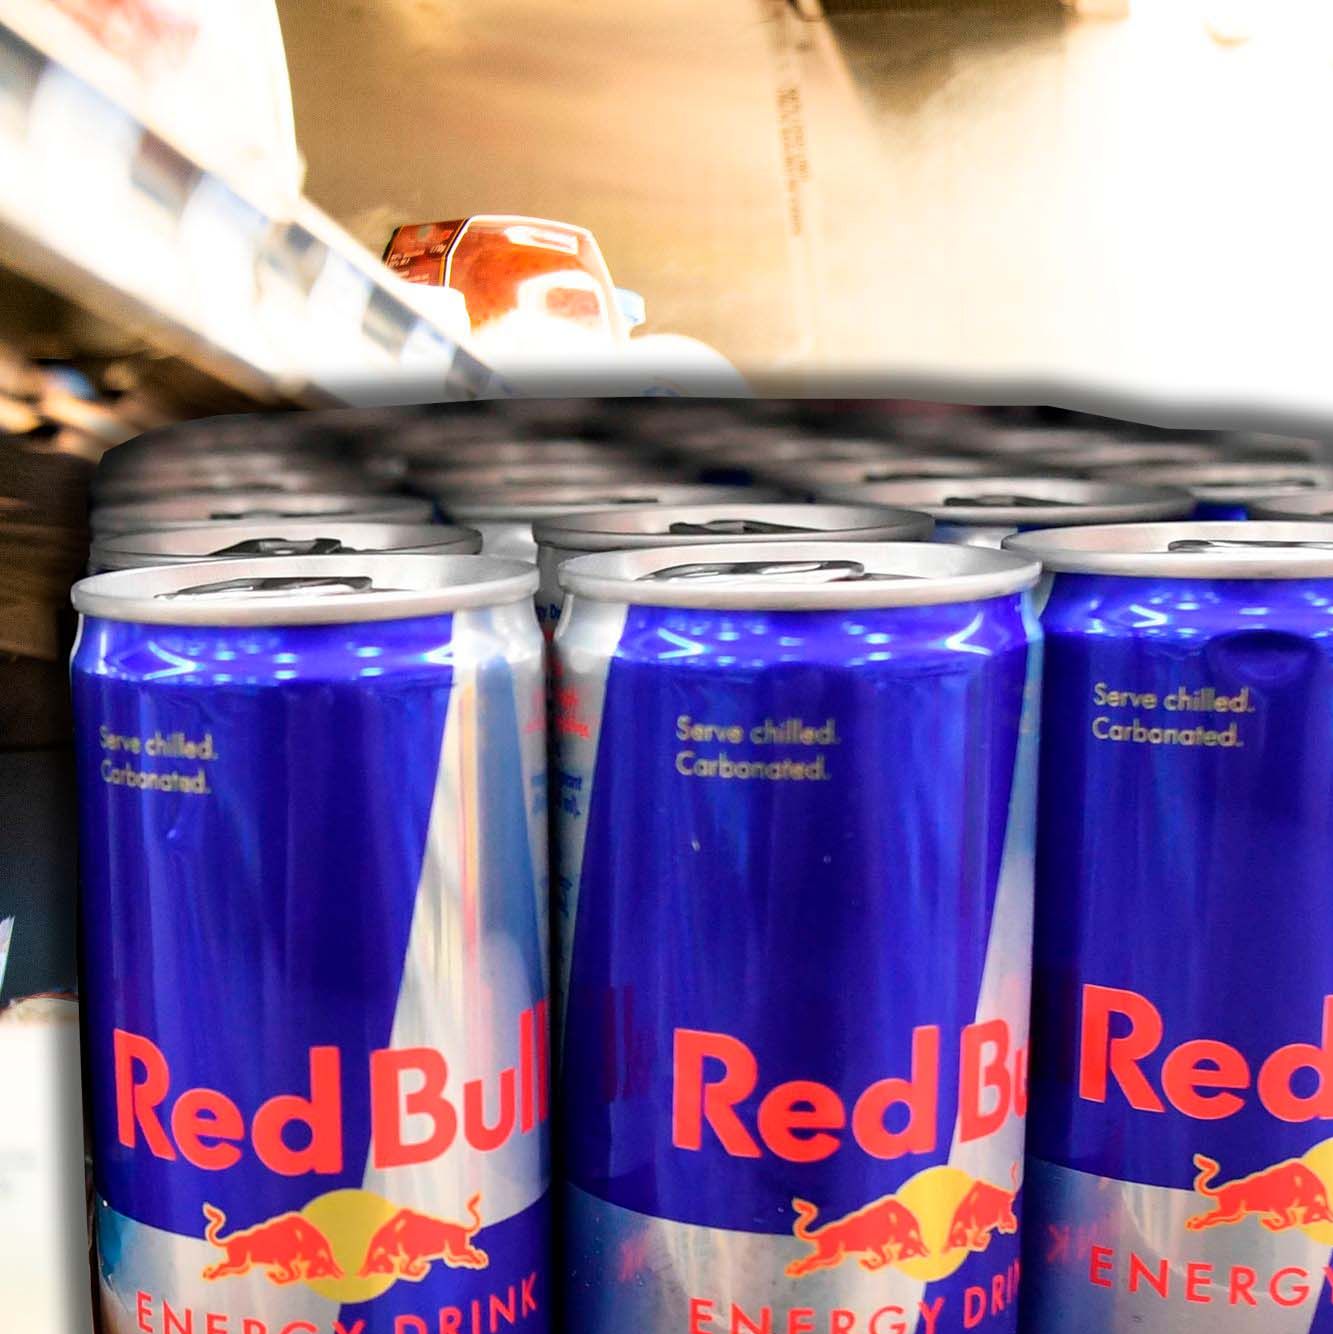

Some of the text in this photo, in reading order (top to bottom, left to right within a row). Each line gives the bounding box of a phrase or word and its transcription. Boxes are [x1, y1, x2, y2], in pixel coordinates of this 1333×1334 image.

[1094, 682, 1255, 713] Serve chilled.
[676, 714, 841, 745] Serve chilled.
[1092, 716, 1244, 747] Carbonated.
[675, 750, 832, 780] Carbonated.
[112, 998, 548, 1177] Red Bull
[672, 1025, 940, 1163] Red
